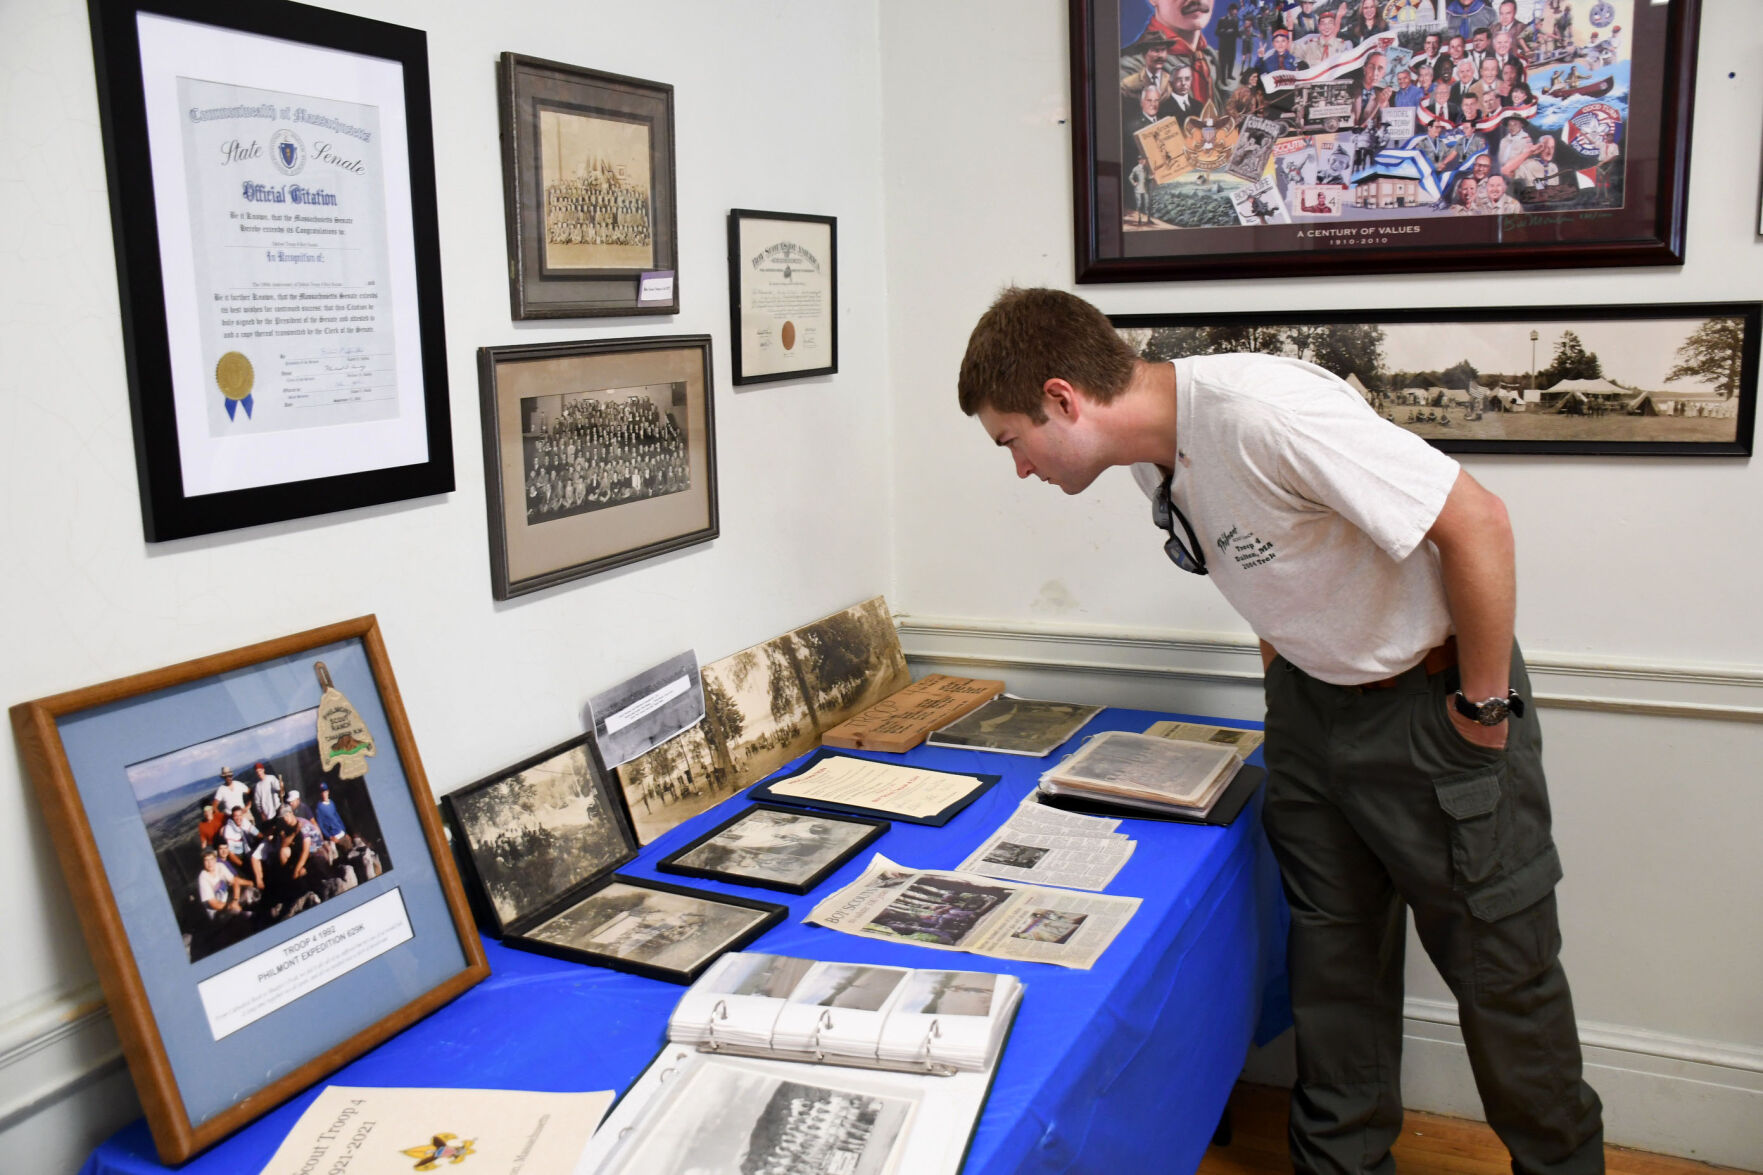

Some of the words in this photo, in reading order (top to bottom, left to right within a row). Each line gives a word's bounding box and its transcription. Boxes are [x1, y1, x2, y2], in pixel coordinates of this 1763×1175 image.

[220, 140, 264, 166] State
[310, 141, 366, 176] Senate
[242, 180, 286, 204] Official
[289, 183, 338, 206] Citation
[1307, 228, 1357, 238] CENTURY
[1378, 226, 1420, 234] VALUES
[1330, 238, 1388, 246] 1910-2010
[266, 251, 276, 262] In
[278, 250, 315, 264] Recognition
[257, 956, 300, 985] PHILMONT
[301, 932, 346, 961] EXPEDITION
[283, 937, 310, 956] TROOP
[316, 1108, 359, 1142] Troop
[327, 1121, 376, 1175] 921-2021
